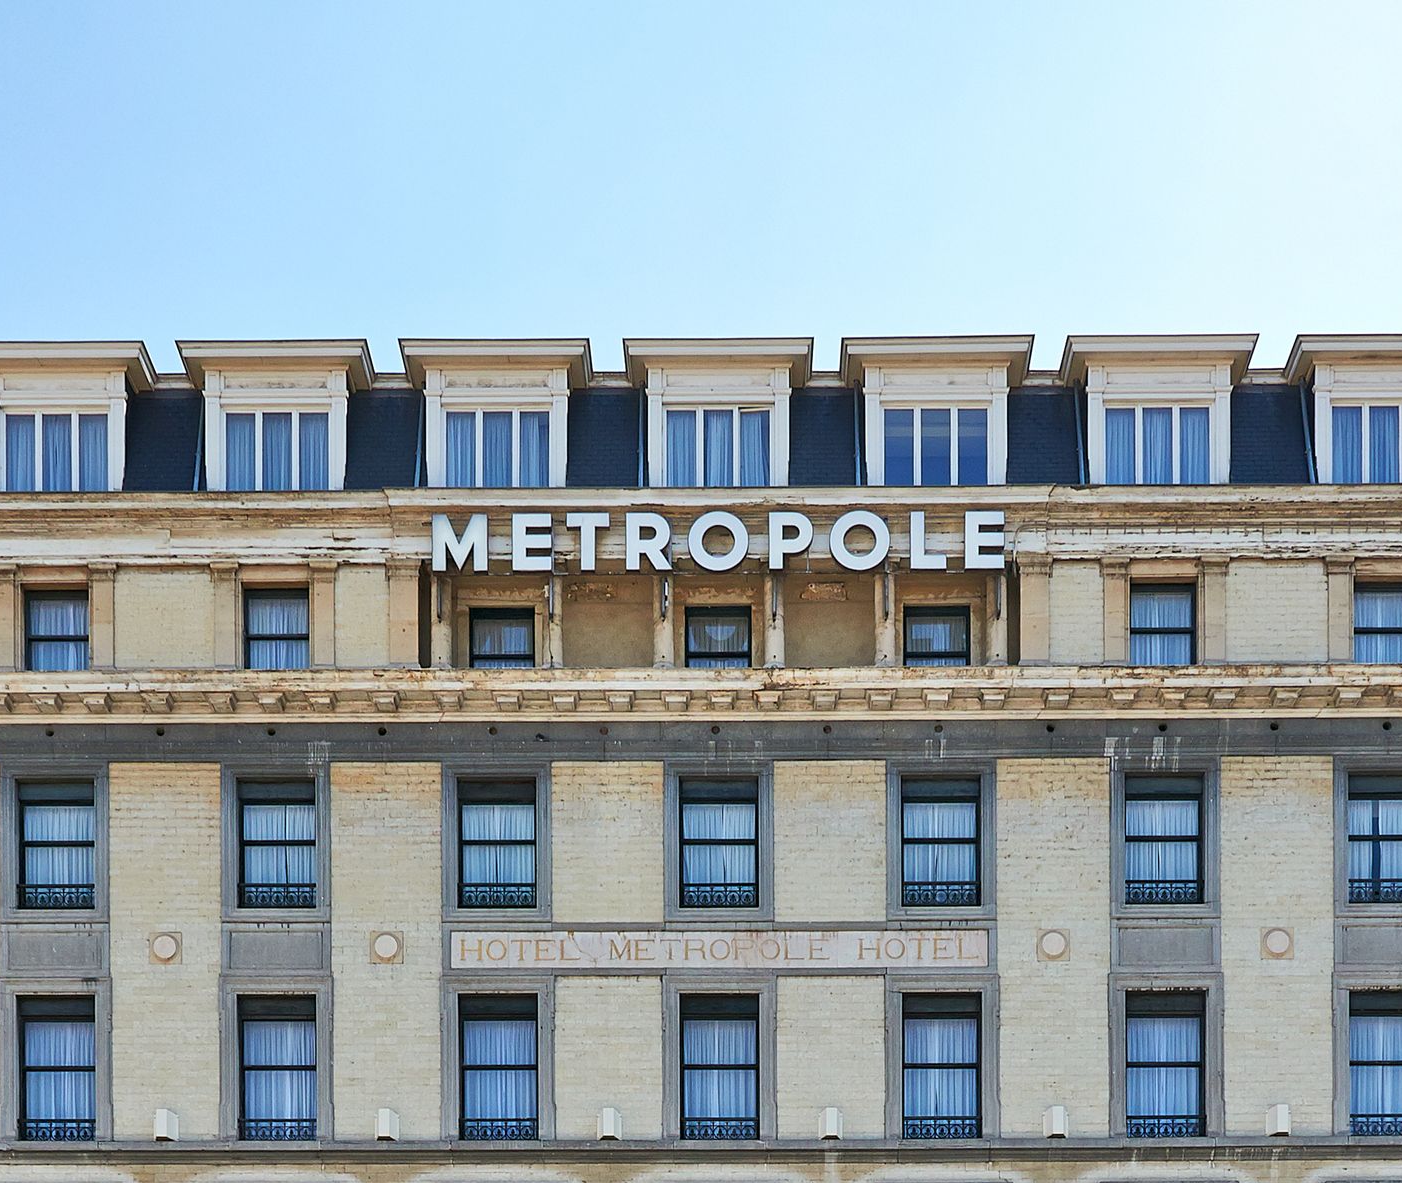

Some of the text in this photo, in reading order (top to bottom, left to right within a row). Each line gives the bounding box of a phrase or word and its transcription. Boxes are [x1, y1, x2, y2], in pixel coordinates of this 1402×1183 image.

[431, 510, 1005, 572] METROPOLE
[460, 937, 979, 961] HOTEL METROPOLE HOTEL
